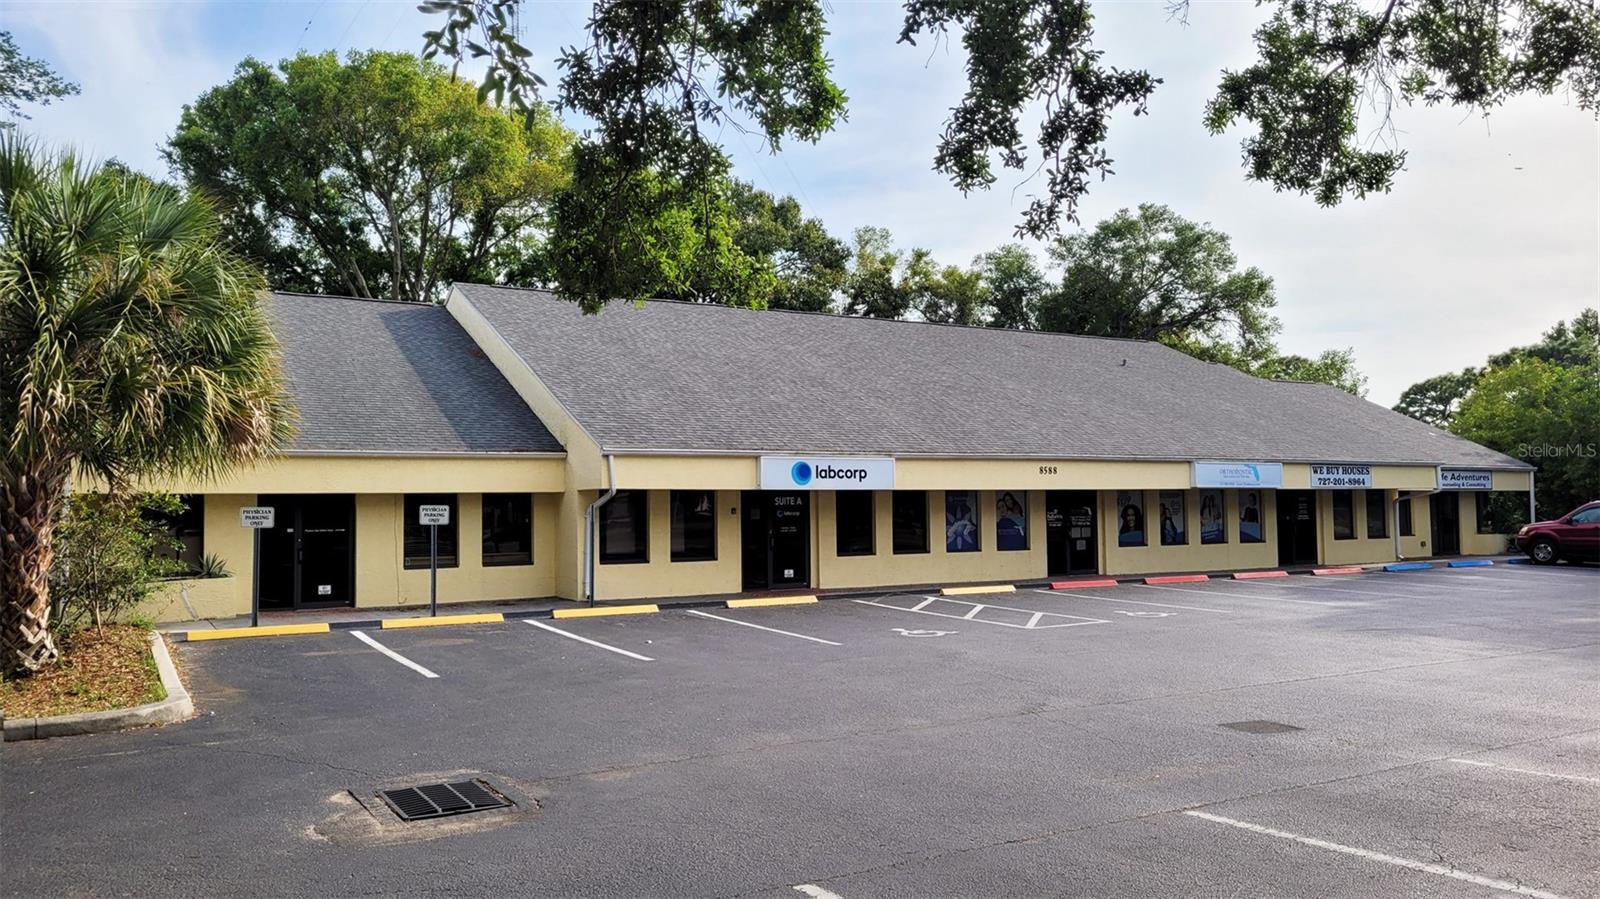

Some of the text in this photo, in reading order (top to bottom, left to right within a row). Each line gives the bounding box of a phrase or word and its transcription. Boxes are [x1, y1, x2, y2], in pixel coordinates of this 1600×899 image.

[815, 465, 868, 482] labcorp
[1039, 466, 1058, 475] 8588
[1312, 466, 1370, 475] WE BUY HOUSES
[1450, 472, 1490, 481] Adventures
[774, 497, 802, 506] SUITE A
